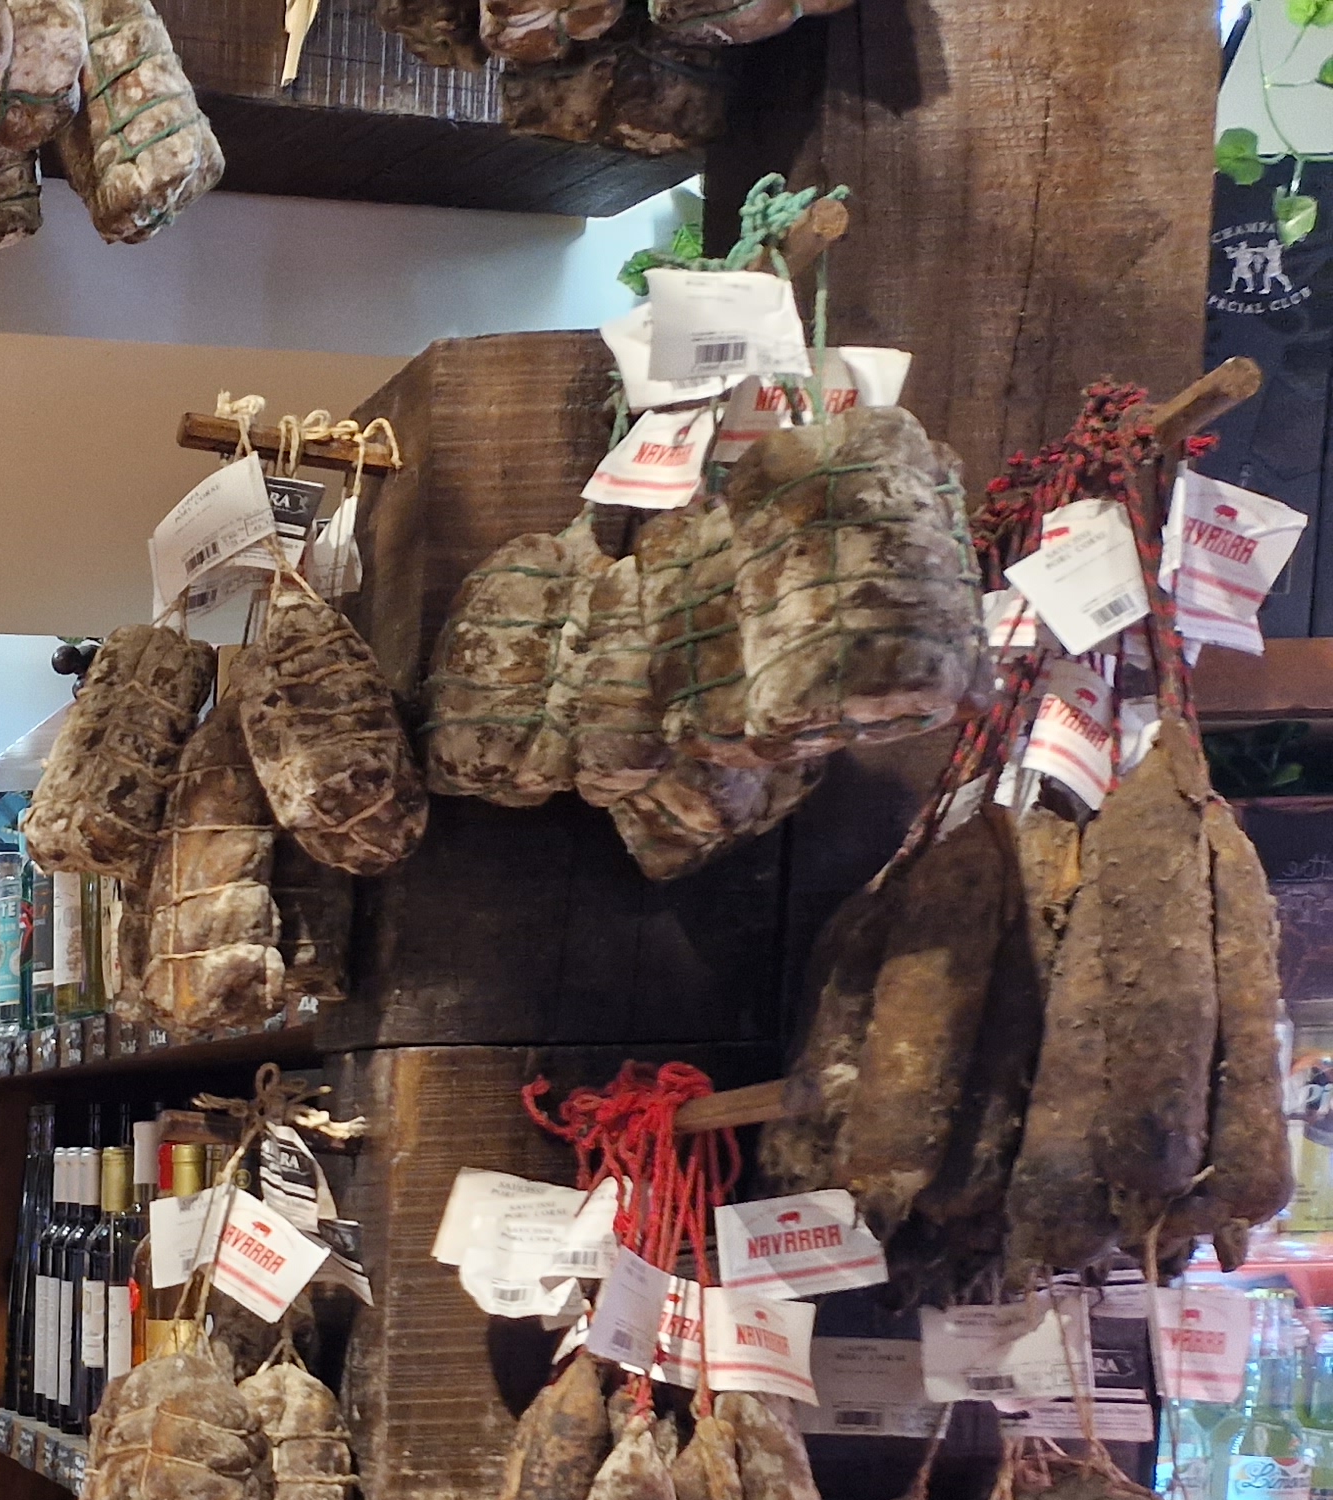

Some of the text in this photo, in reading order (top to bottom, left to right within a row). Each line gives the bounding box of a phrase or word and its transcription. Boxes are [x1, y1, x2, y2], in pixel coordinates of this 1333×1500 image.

[1211, 220, 1277, 243] CHAMPA
[1207, 295, 1266, 314] PECIAL
[1183, 517, 1259, 565] AVARRA
[1036, 696, 1110, 749] AVARRA
[222, 1222, 287, 1276] AVARRA
[747, 1223, 843, 1260] NAVARRA
